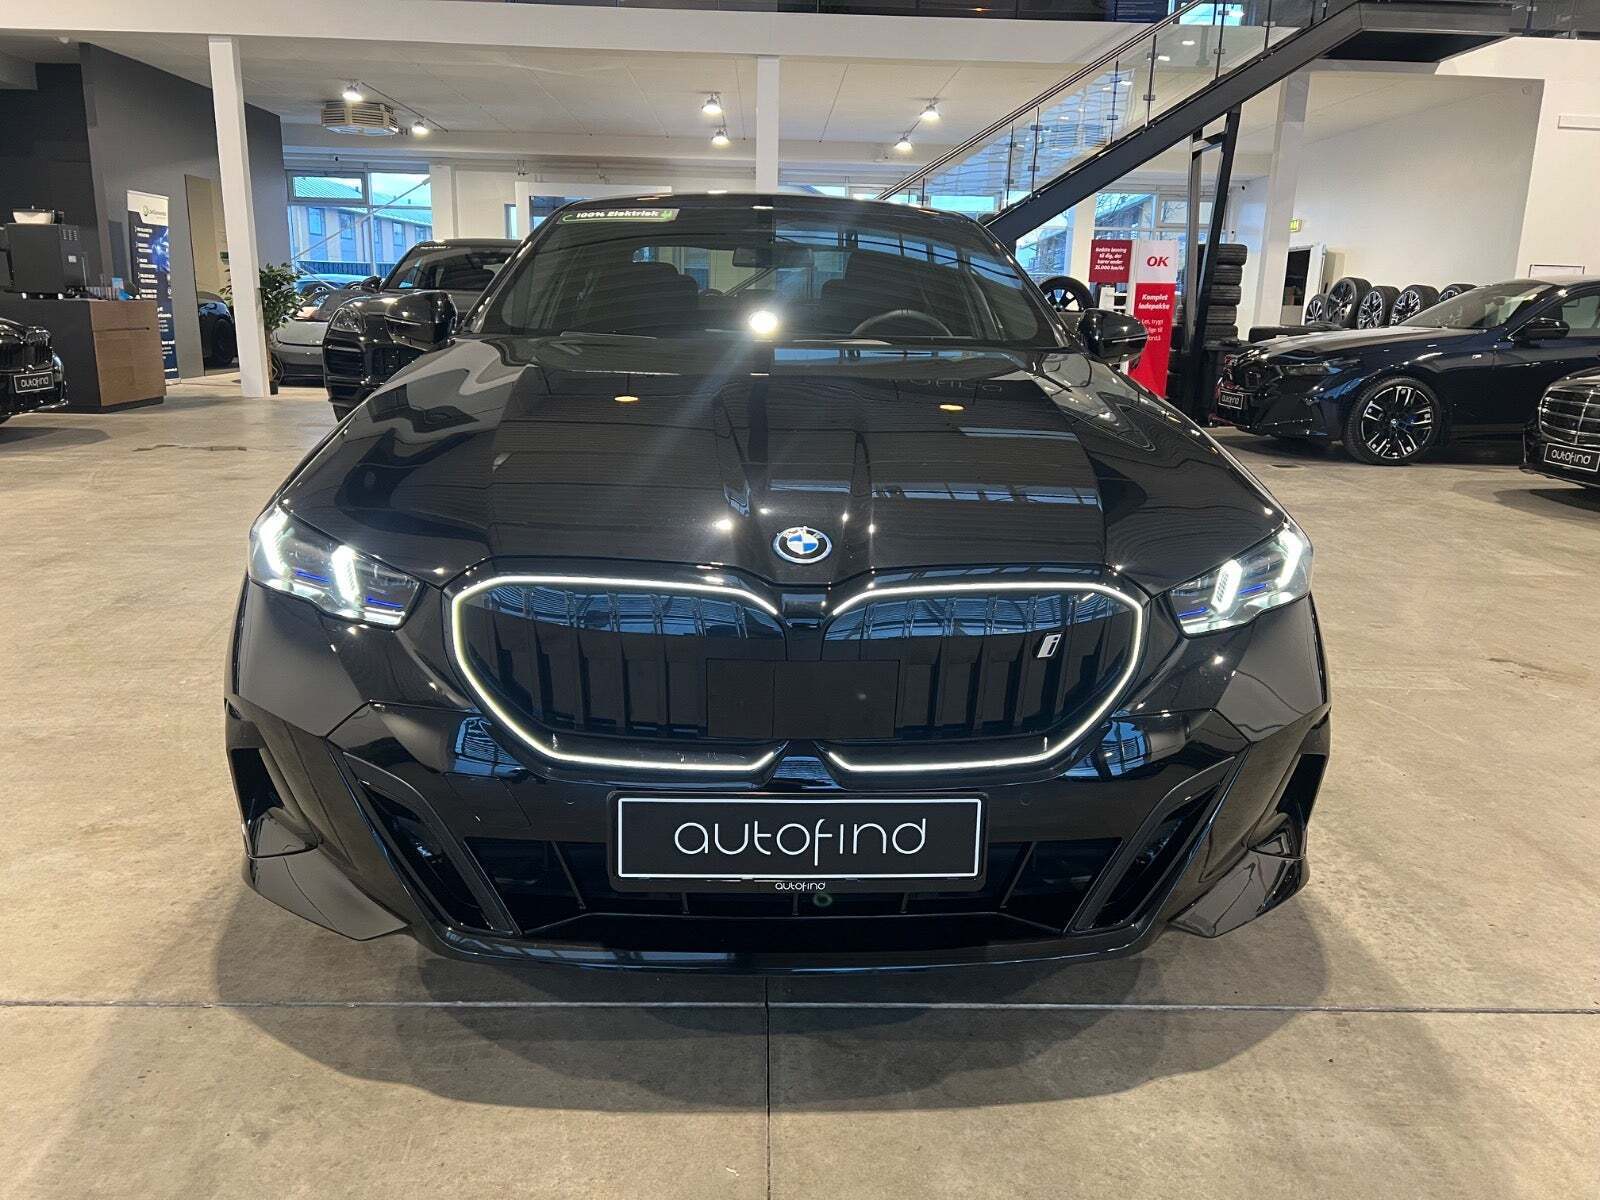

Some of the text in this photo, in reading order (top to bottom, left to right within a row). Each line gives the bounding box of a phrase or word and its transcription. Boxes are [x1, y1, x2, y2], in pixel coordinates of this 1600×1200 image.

[1146, 256, 1169, 267] OK
[1142, 294, 1168, 302] Komplet
[1138, 302, 1170, 310] ladepakke
[1551, 449, 1591, 464] autofind
[674, 818, 926, 866] autofind
[774, 881, 826, 891] autofind
